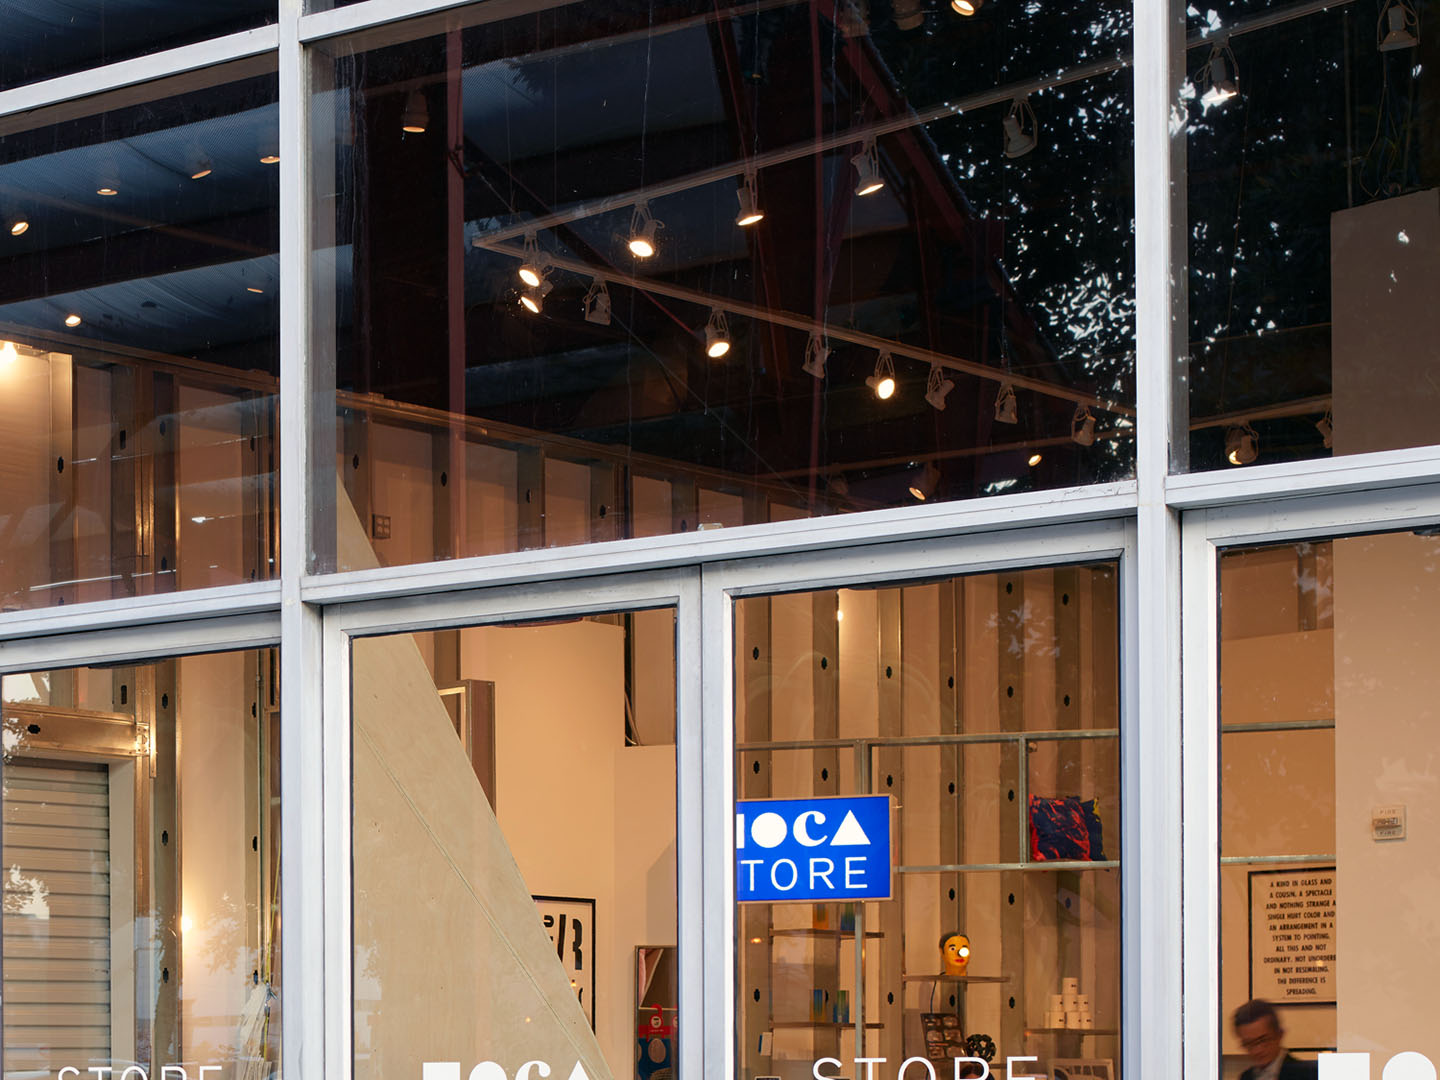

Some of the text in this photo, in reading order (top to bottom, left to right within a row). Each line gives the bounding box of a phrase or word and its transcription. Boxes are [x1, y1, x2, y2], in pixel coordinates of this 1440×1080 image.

[736, 810, 871, 848] OCA
[740, 856, 868, 891] TORE
[1301, 878, 1318, 886] GLASS
[1305, 889, 1332, 897] SPECTACLE
[1279, 901, 1304, 909] NOTHING
[1306, 900, 1330, 908] STRANGE
[1279, 922, 1318, 931] ARRANGEMENT
[1308, 954, 1336, 962] UNORDERE
